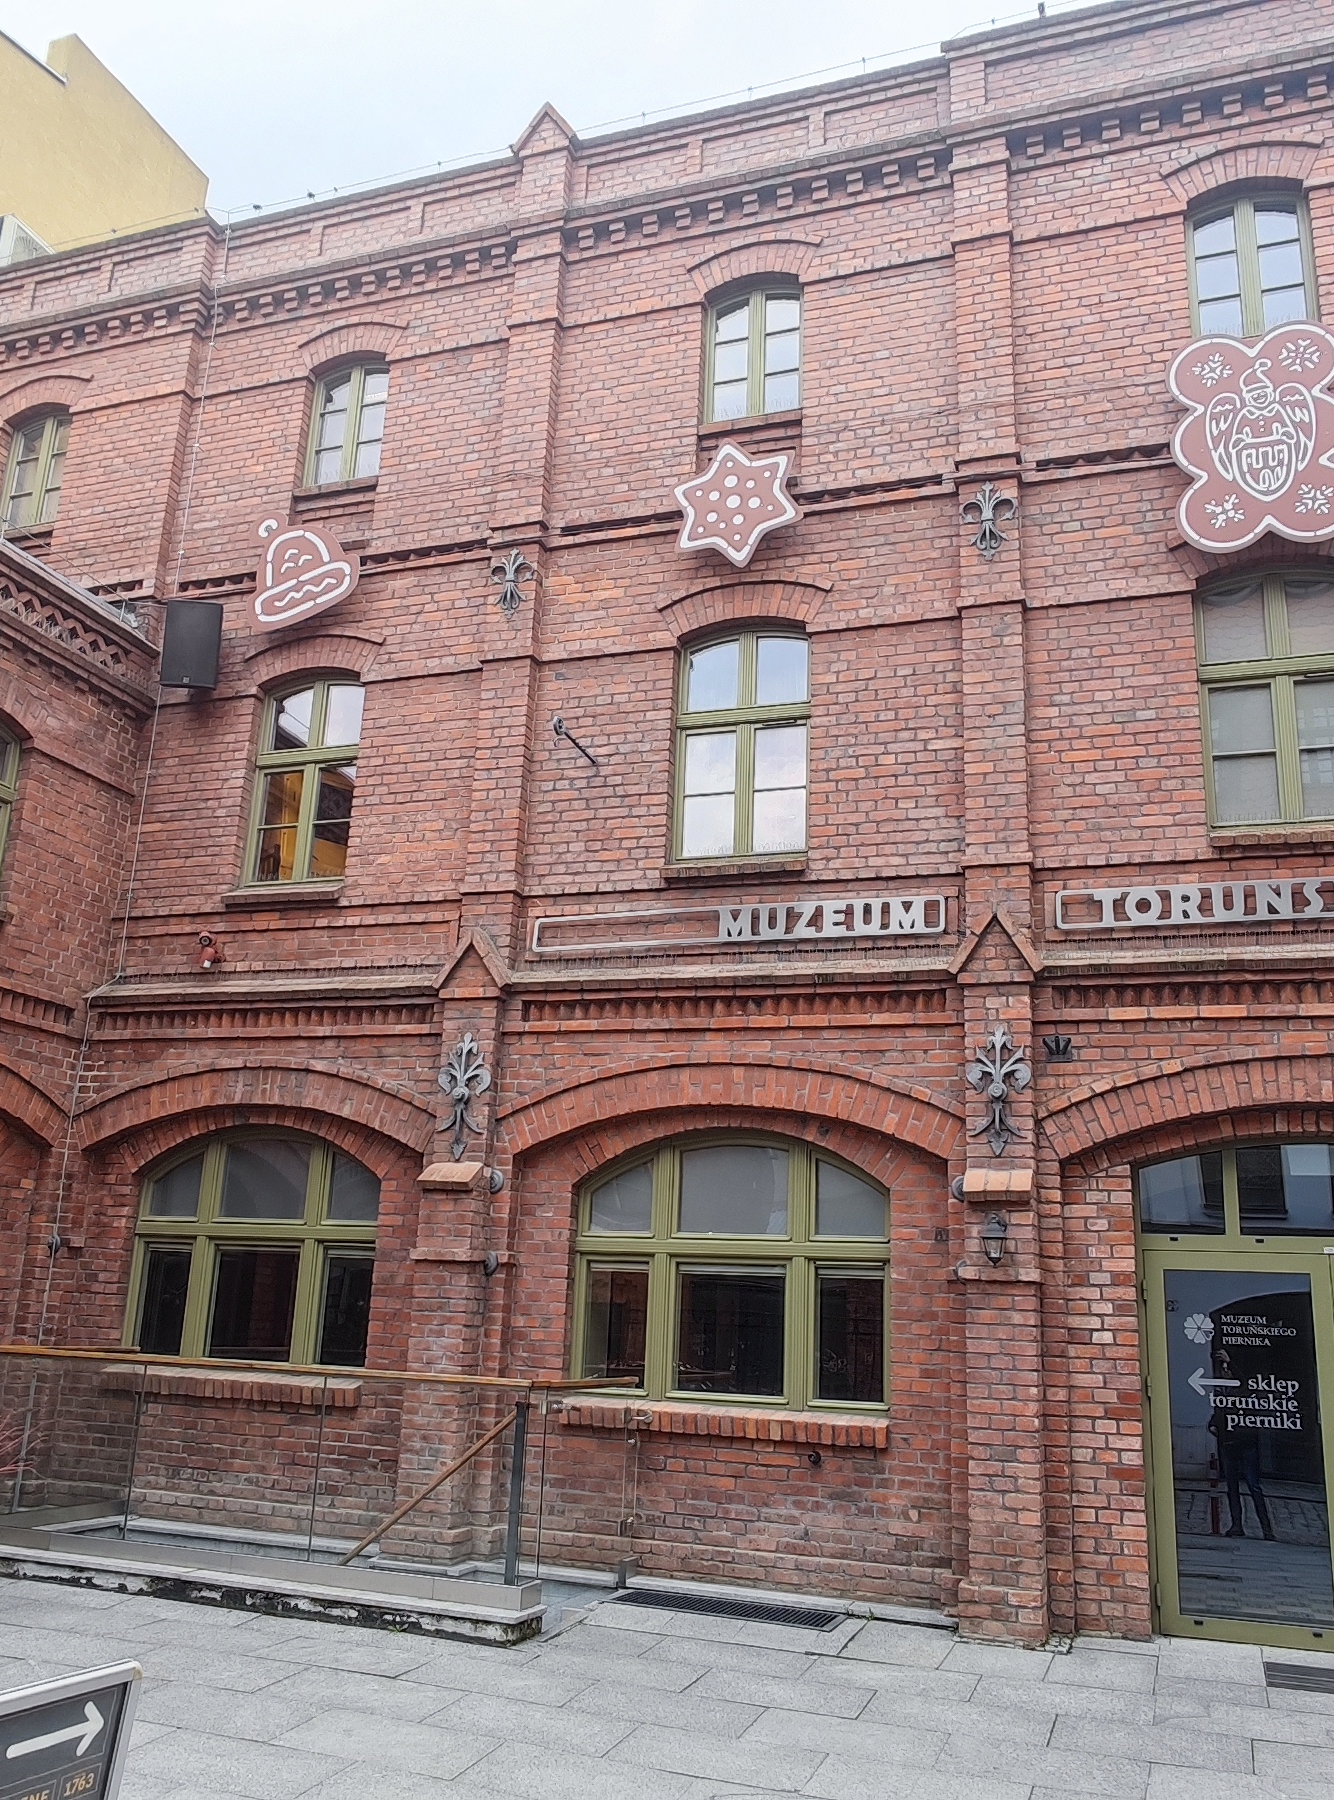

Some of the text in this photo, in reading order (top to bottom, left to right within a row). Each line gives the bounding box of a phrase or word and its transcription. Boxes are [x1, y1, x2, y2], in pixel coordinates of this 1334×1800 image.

[719, 899, 925, 938] MUZEUM
[1221, 1315, 1267, 1324] MUZEUM
[1221, 1325, 1297, 1336] TORUŃSKIEGO
[1222, 1336, 1271, 1346] PIERNIKA
[1248, 1374, 1299, 1397] sklep
[1209, 1392, 1298, 1411] toruńskie
[1226, 1410, 1303, 1431] pierniki
[64, 1772, 95, 1797] 1763
